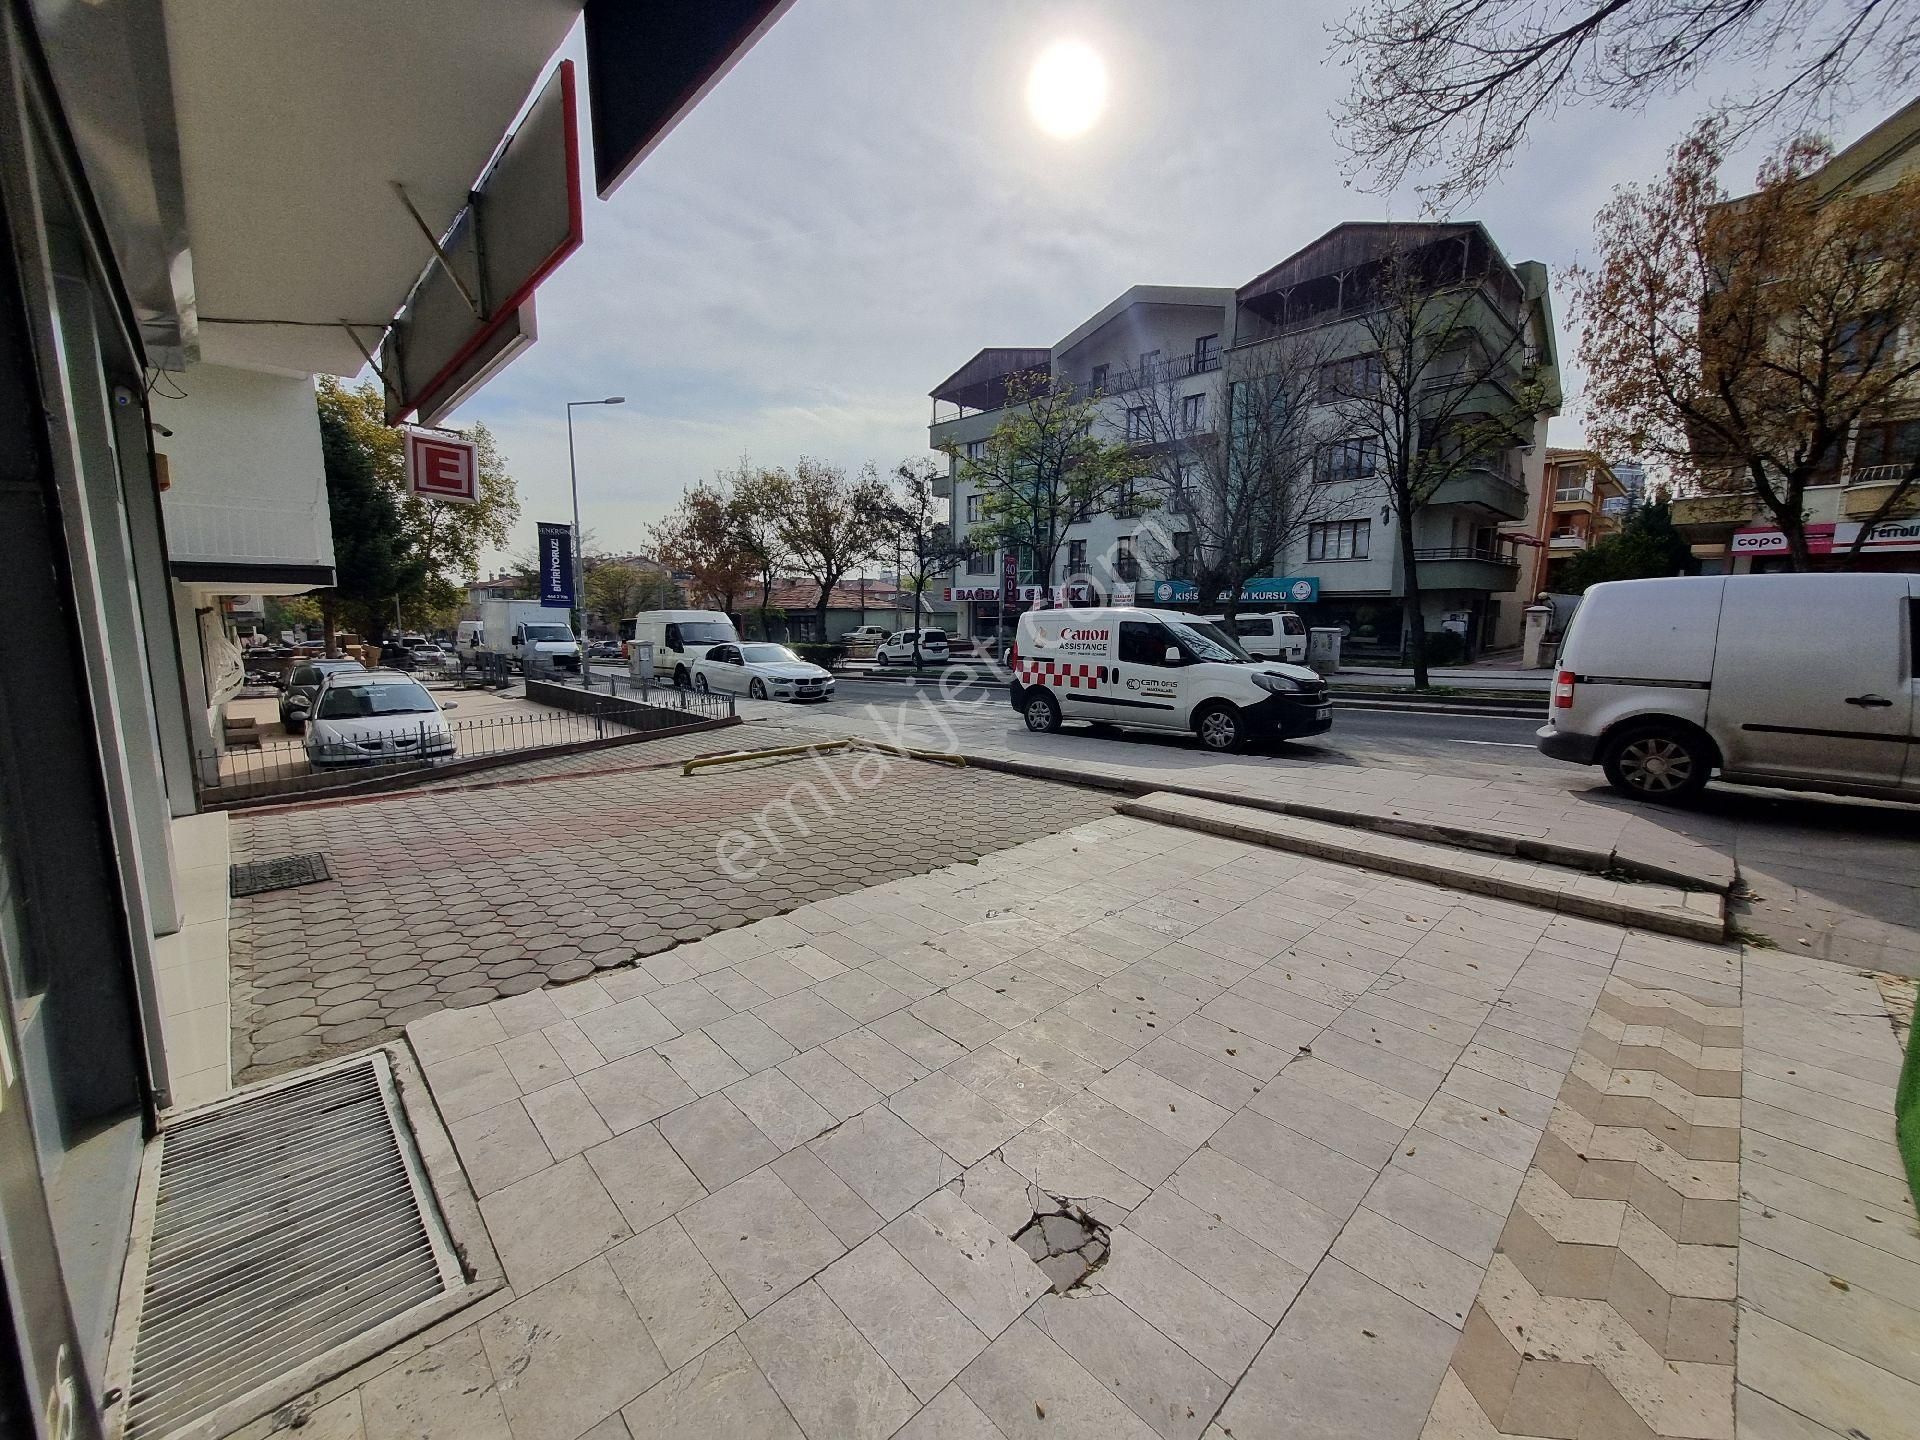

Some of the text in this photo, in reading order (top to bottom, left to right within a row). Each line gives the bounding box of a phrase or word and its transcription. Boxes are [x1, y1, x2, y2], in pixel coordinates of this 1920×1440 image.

[426, 447, 462, 490] E
[1738, 537, 1782, 549] copa
[1251, 591, 1287, 600] KURSU
[1060, 627, 1109, 641] Canon
[1058, 642, 1108, 651] ASSISTANCE
